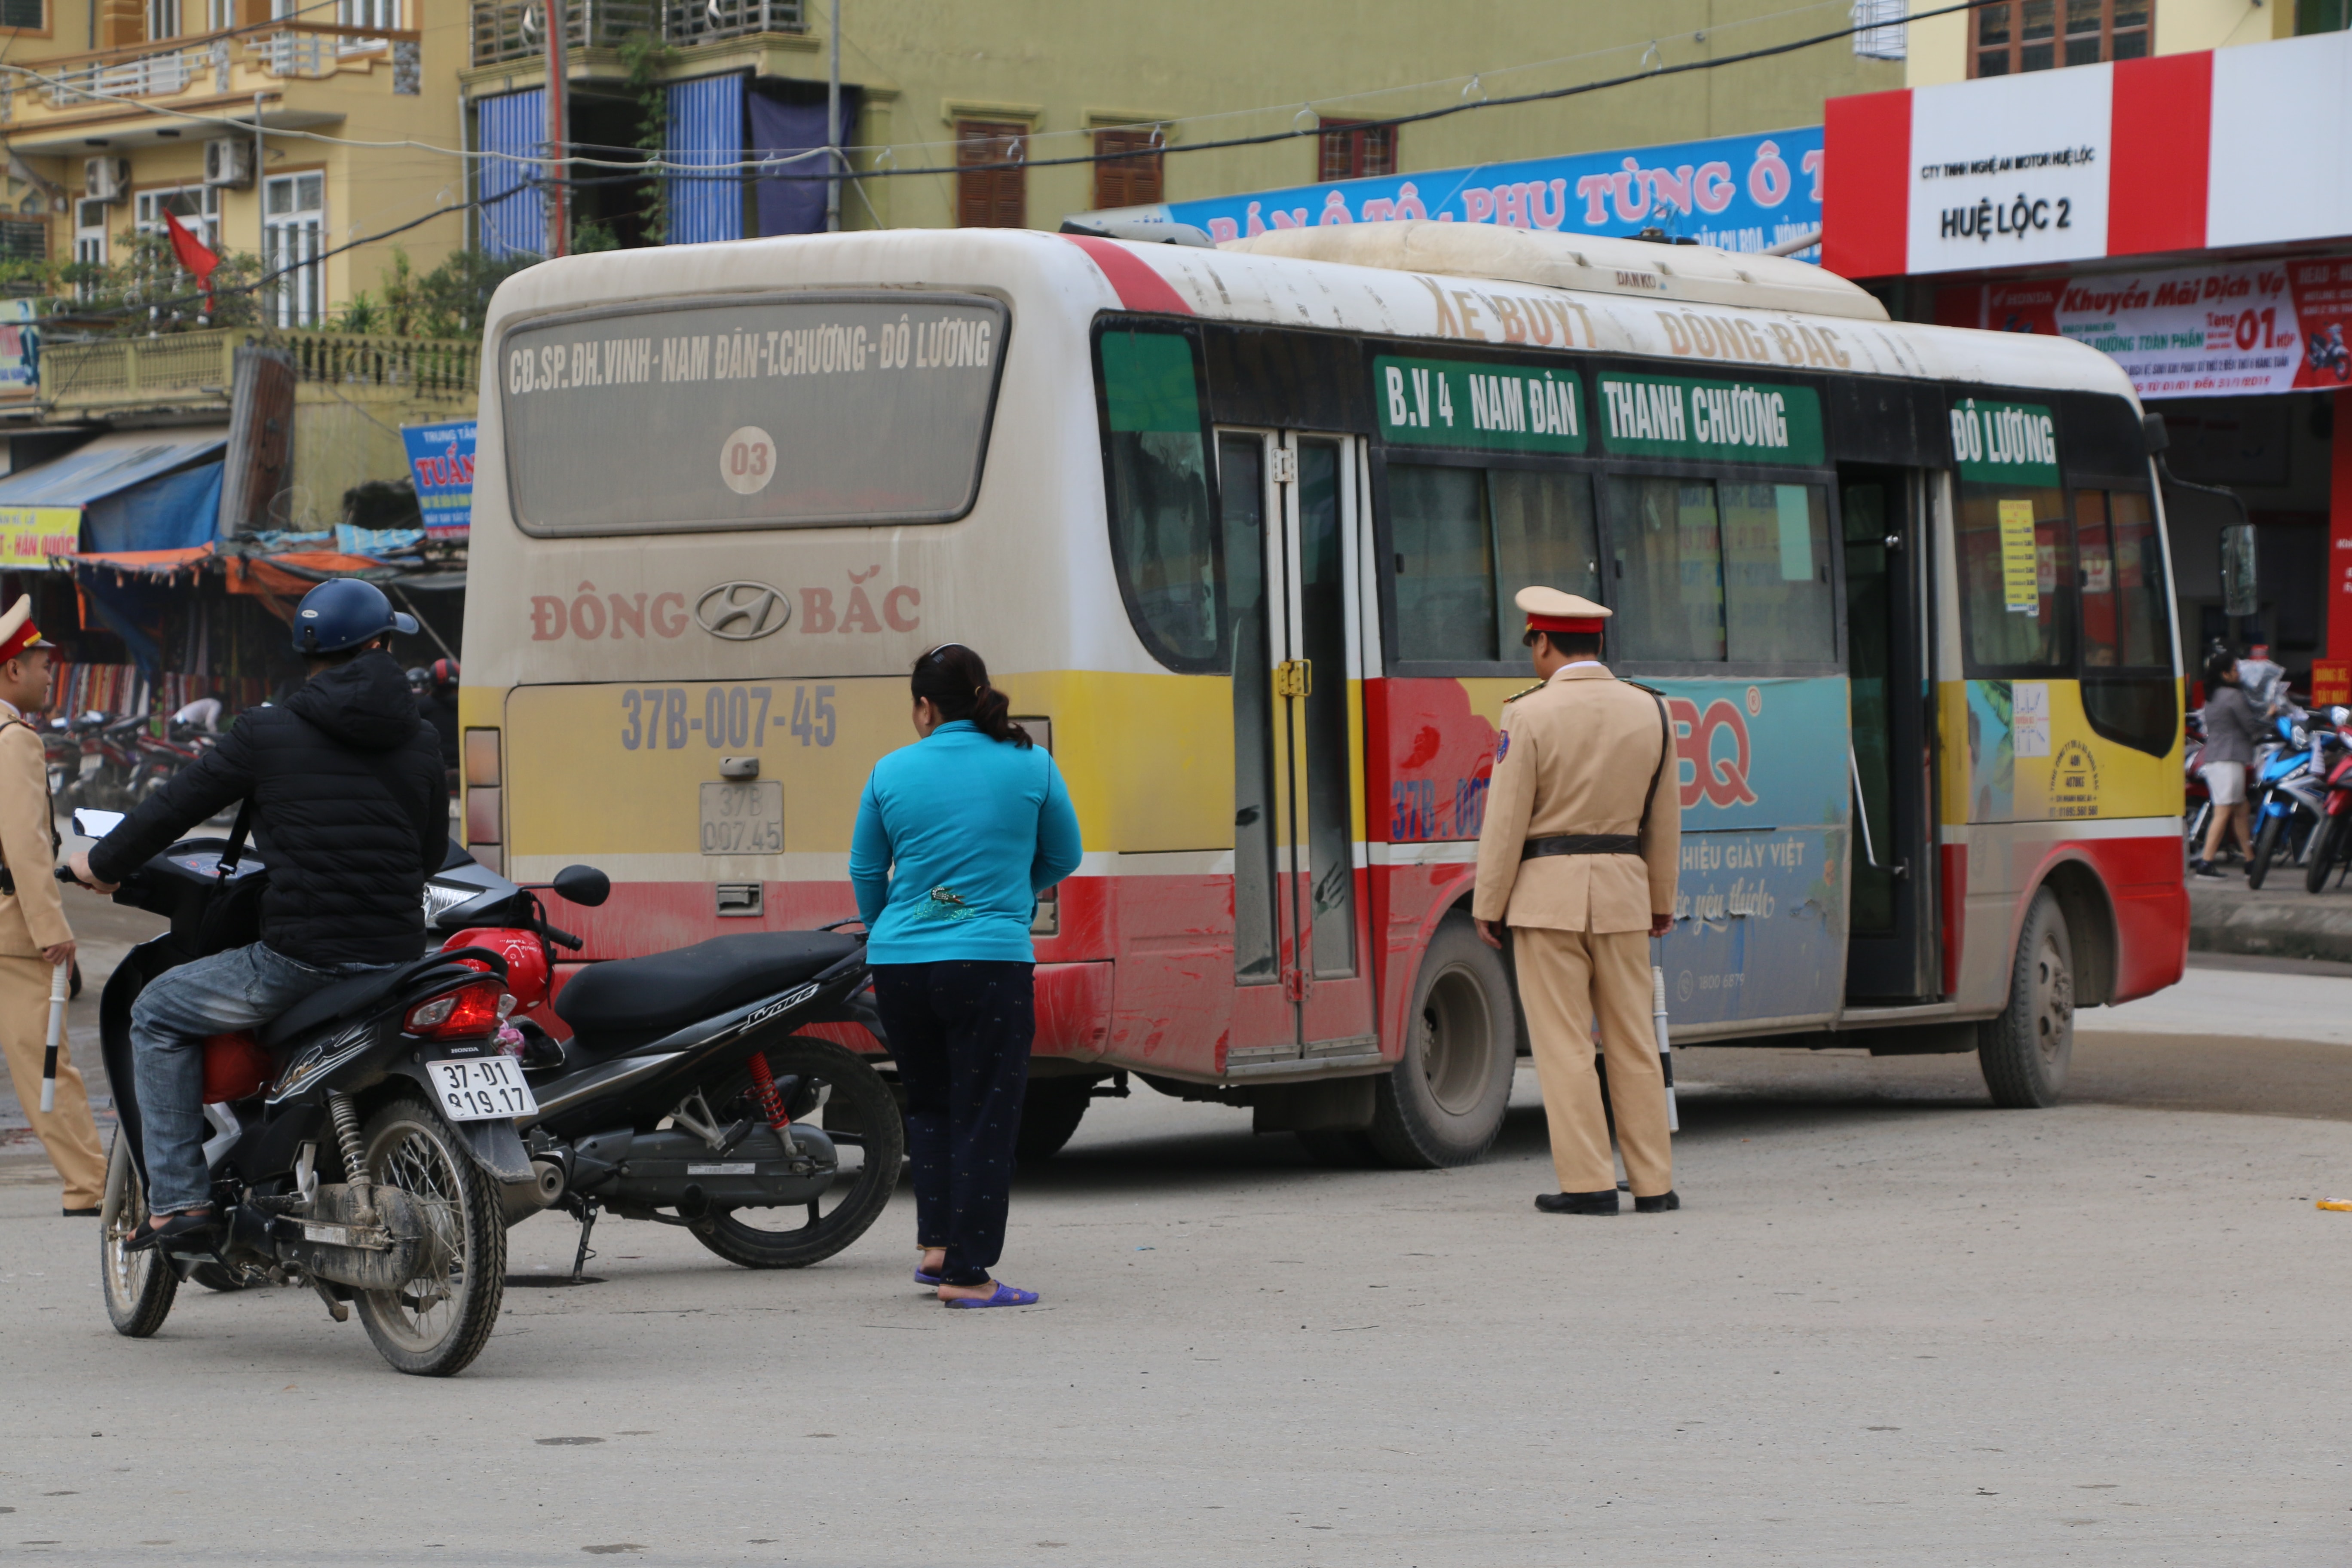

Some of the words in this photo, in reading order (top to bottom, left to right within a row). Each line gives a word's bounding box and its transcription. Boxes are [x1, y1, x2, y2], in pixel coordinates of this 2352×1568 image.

[1577, 156, 1736, 226] TÙNG
[1747, 139, 1791, 208] Ô
[1922, 164, 1941, 178] CTY
[2015, 152, 2051, 169] MOTOR
[2074, 144, 2095, 165] LỘC
[1942, 196, 1992, 242] HUỆ
[1997, 192, 2049, 239] LỘC
[2056, 197, 2071, 228] 2
[1615, 270, 1656, 289] DANKO
[2006, 292, 2055, 304] HONDA
[2061, 279, 2150, 315] Khuyến
[2203, 274, 2251, 304] Dịch
[1411, 275, 1486, 340] XE
[2236, 307, 2277, 351] 01
[916, 316, 991, 368] LƯƠNG
[1385, 366, 1430, 428] B.V
[1438, 371, 1453, 427] 4
[1469, 373, 1526, 431] NAM
[1529, 371, 1578, 436] ĐÀN
[1603, 381, 1686, 441] THANH
[1690, 383, 1788, 447] CHƯƠNG
[1950, 398, 1982, 462] ĐÔ
[1984, 406, 2057, 464] LƯƠNG
[730, 442, 768, 475] 03
[530, 580, 690, 641] ĐÔNG
[799, 564, 922, 634] BẮC
[621, 686, 836, 750] 37B-007-45
[720, 787, 763, 817] 37B
[702, 821, 781, 851] 007.45
[1681, 839, 1721, 877] HIỆU
[1725, 837, 1766, 869] GIÀY
[1770, 836, 1805, 873] VIỆT
[1729, 876, 1775, 919] thích
[1723, 973, 1746, 988] 6879
[443, 1062, 510, 1088] 37-D1
